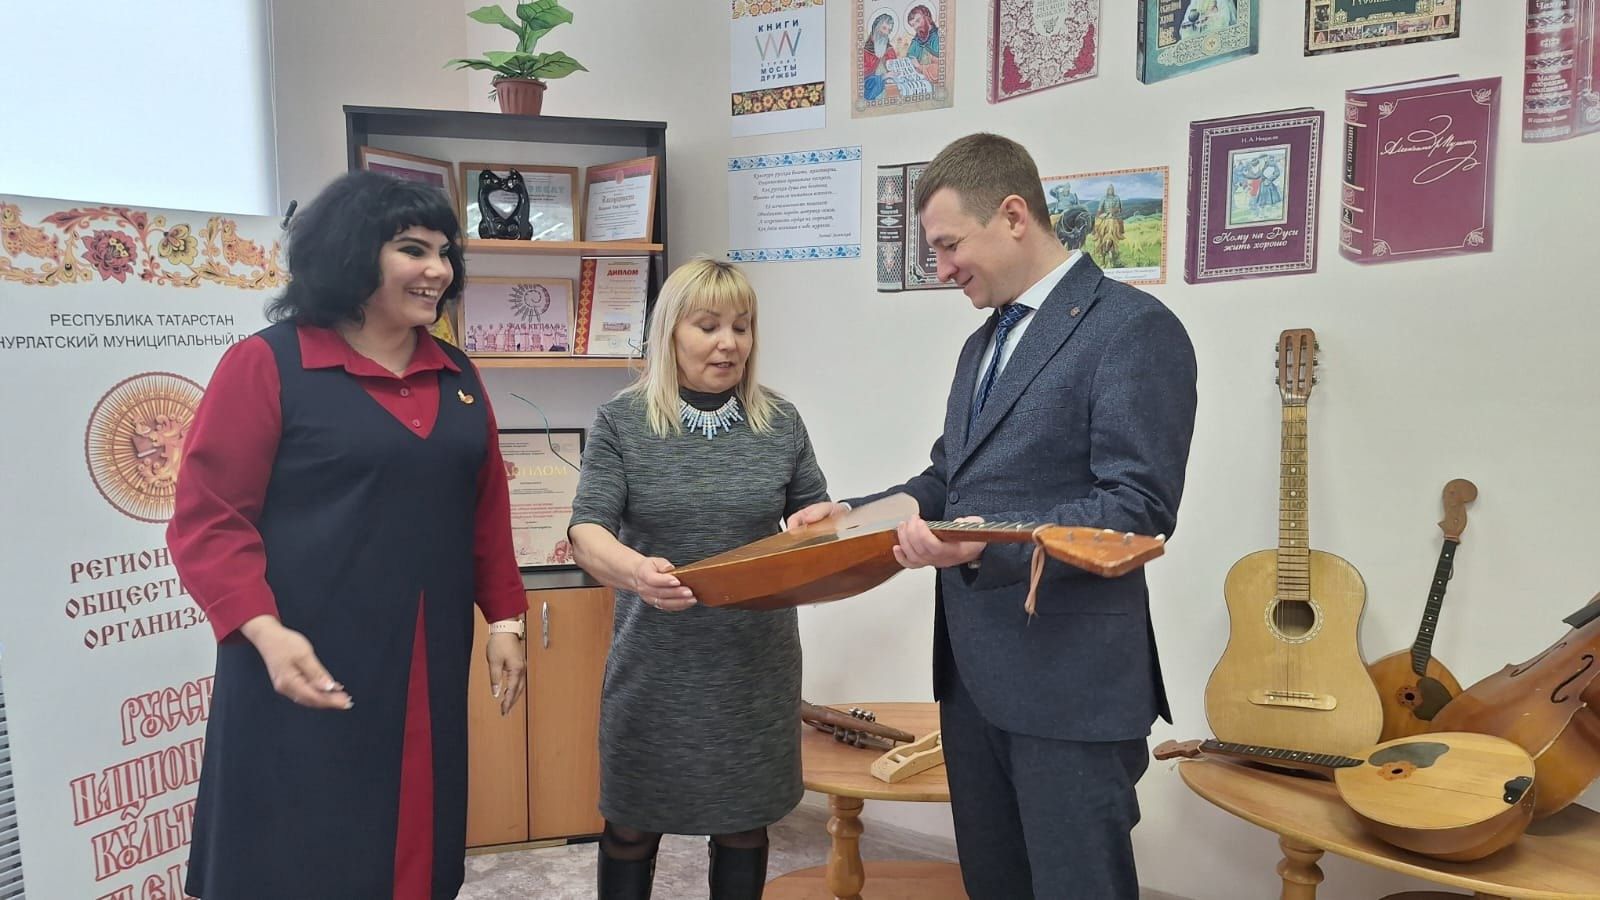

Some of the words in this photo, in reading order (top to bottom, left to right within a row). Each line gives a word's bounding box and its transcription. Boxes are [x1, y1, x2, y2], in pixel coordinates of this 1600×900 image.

[758, 19, 799, 33] КНИГИ
[761, 63, 797, 74] МОСТЫ
[761, 71, 797, 81] ДРУЖБЫ
[1213, 231, 1249, 244] Кому
[1252, 232, 1264, 240] на
[1266, 226, 1299, 241] Руси
[1223, 243, 1251, 252] жить
[1253, 240, 1288, 252] хорошо
[607, 269, 639, 277] ДИПЛОМ
[50, 313, 153, 327] РЕСПУБЛИКА
[157, 314, 234, 326] ТАТАРСТАН
[103, 332, 235, 350] МУНИЦИПАЛЬНЫЙ
[70, 547, 171, 584] РЕГИОН
